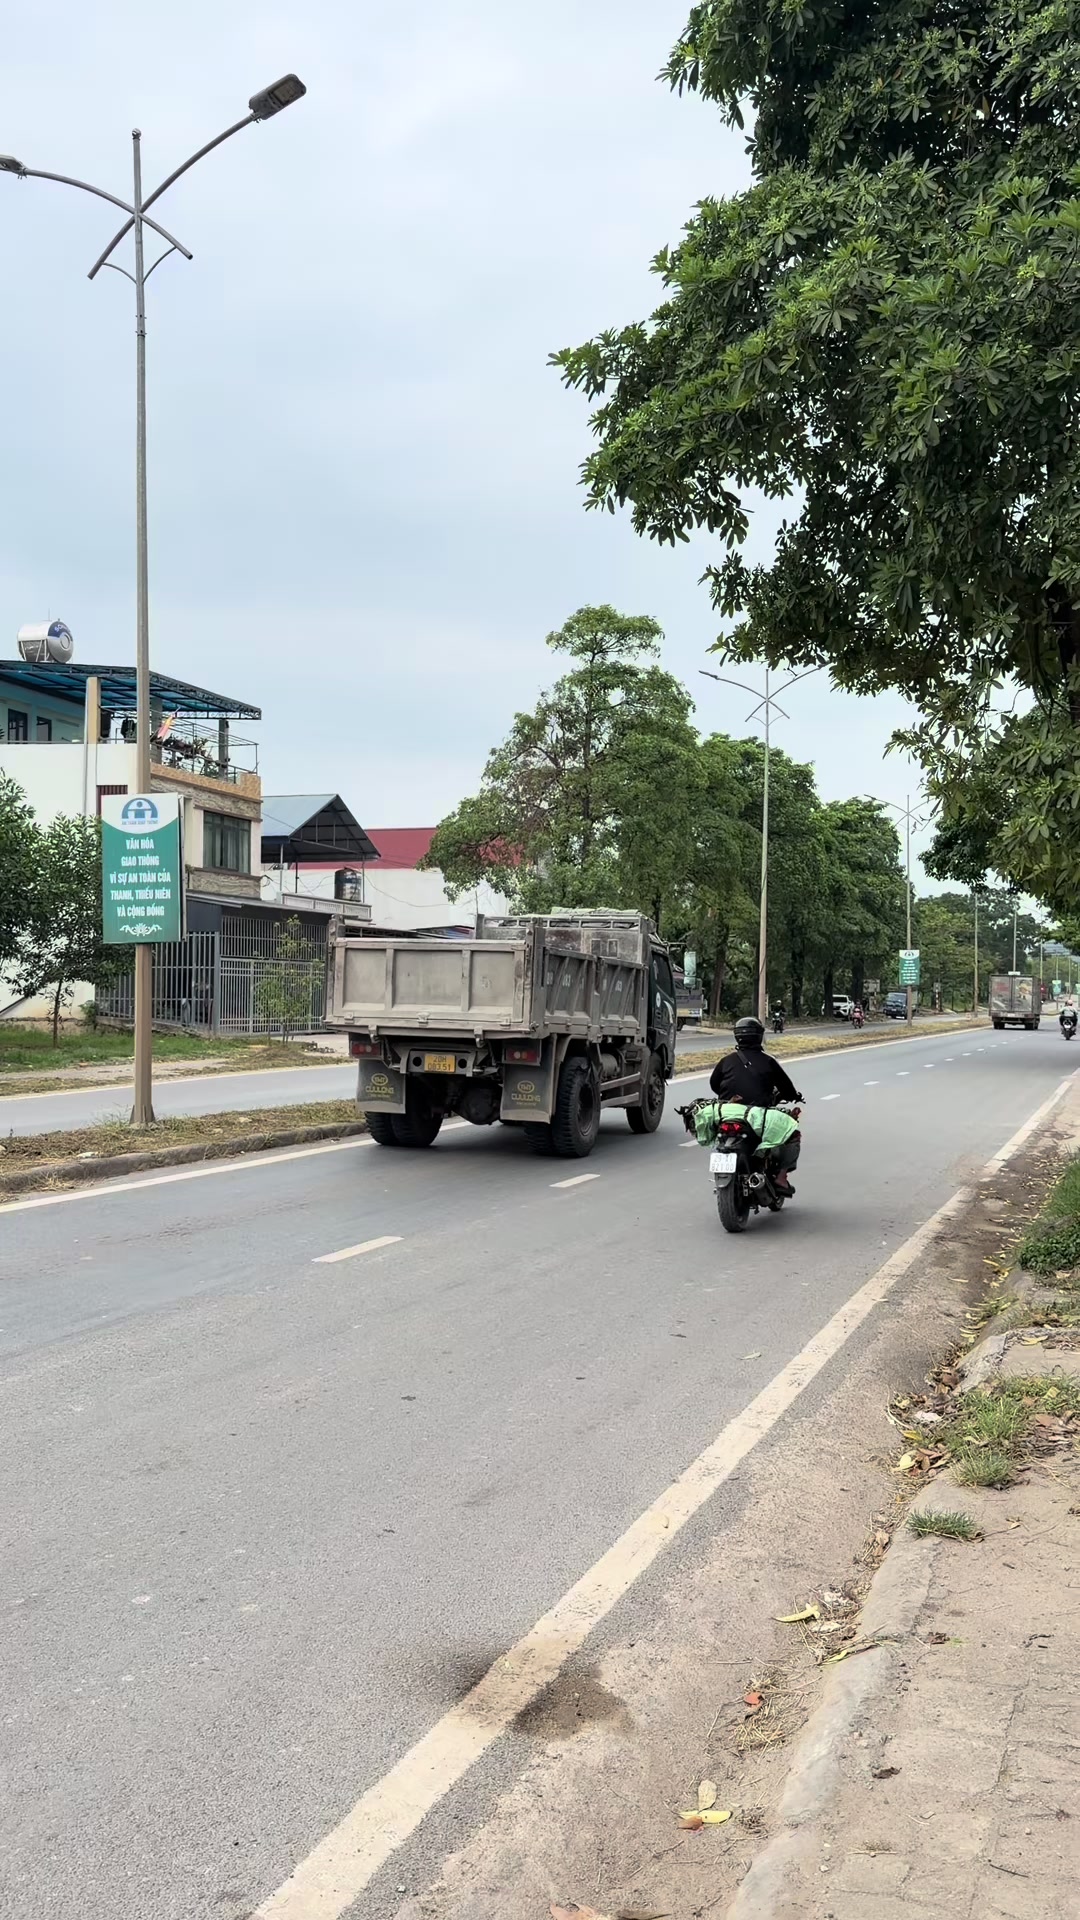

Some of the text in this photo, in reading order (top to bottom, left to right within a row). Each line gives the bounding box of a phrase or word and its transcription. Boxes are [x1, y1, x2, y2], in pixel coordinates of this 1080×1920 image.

[126, 837, 154, 850] VĂN HÓA
[121, 854, 160, 867] GIAO THÔNG
[117, 872, 128, 886] SỰ
[128, 872, 138, 883] AN
[139, 870, 157, 883] TOÀN
[158, 868, 171, 883] CỦA
[110, 886, 171, 901] THANH, THIẾU NIÊN
[117, 904, 126, 917] VÀ
[127, 904, 146, 919] CỘNG
